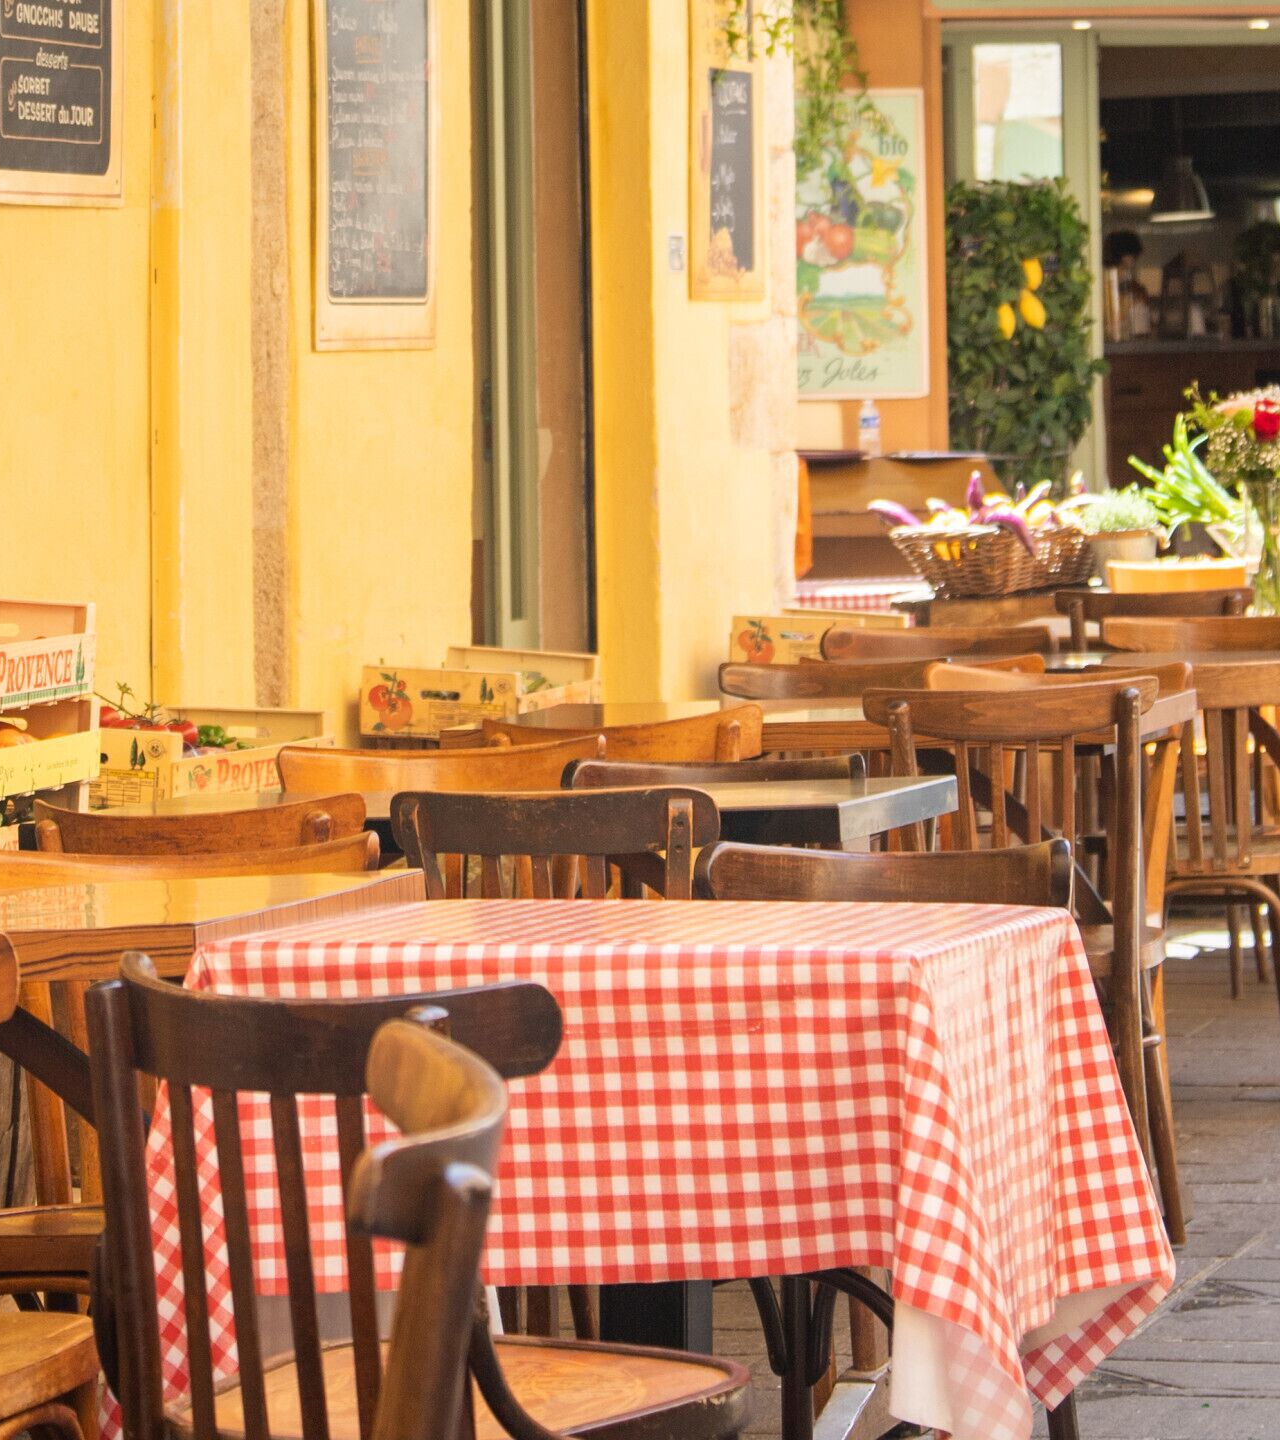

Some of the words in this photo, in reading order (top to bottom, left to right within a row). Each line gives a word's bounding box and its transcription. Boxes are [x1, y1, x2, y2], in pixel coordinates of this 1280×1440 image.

[16, 3, 63, 29] GNOCCHIS
[69, 10, 100, 34] DAUBE
[35, 47, 70, 71] desserts
[17, 74, 51, 96] SORBET
[17, 100, 57, 124] DESSERT
[58, 105, 70, 124] du
[70, 105, 94, 127] JOUR
[879, 133, 909, 157] bio
